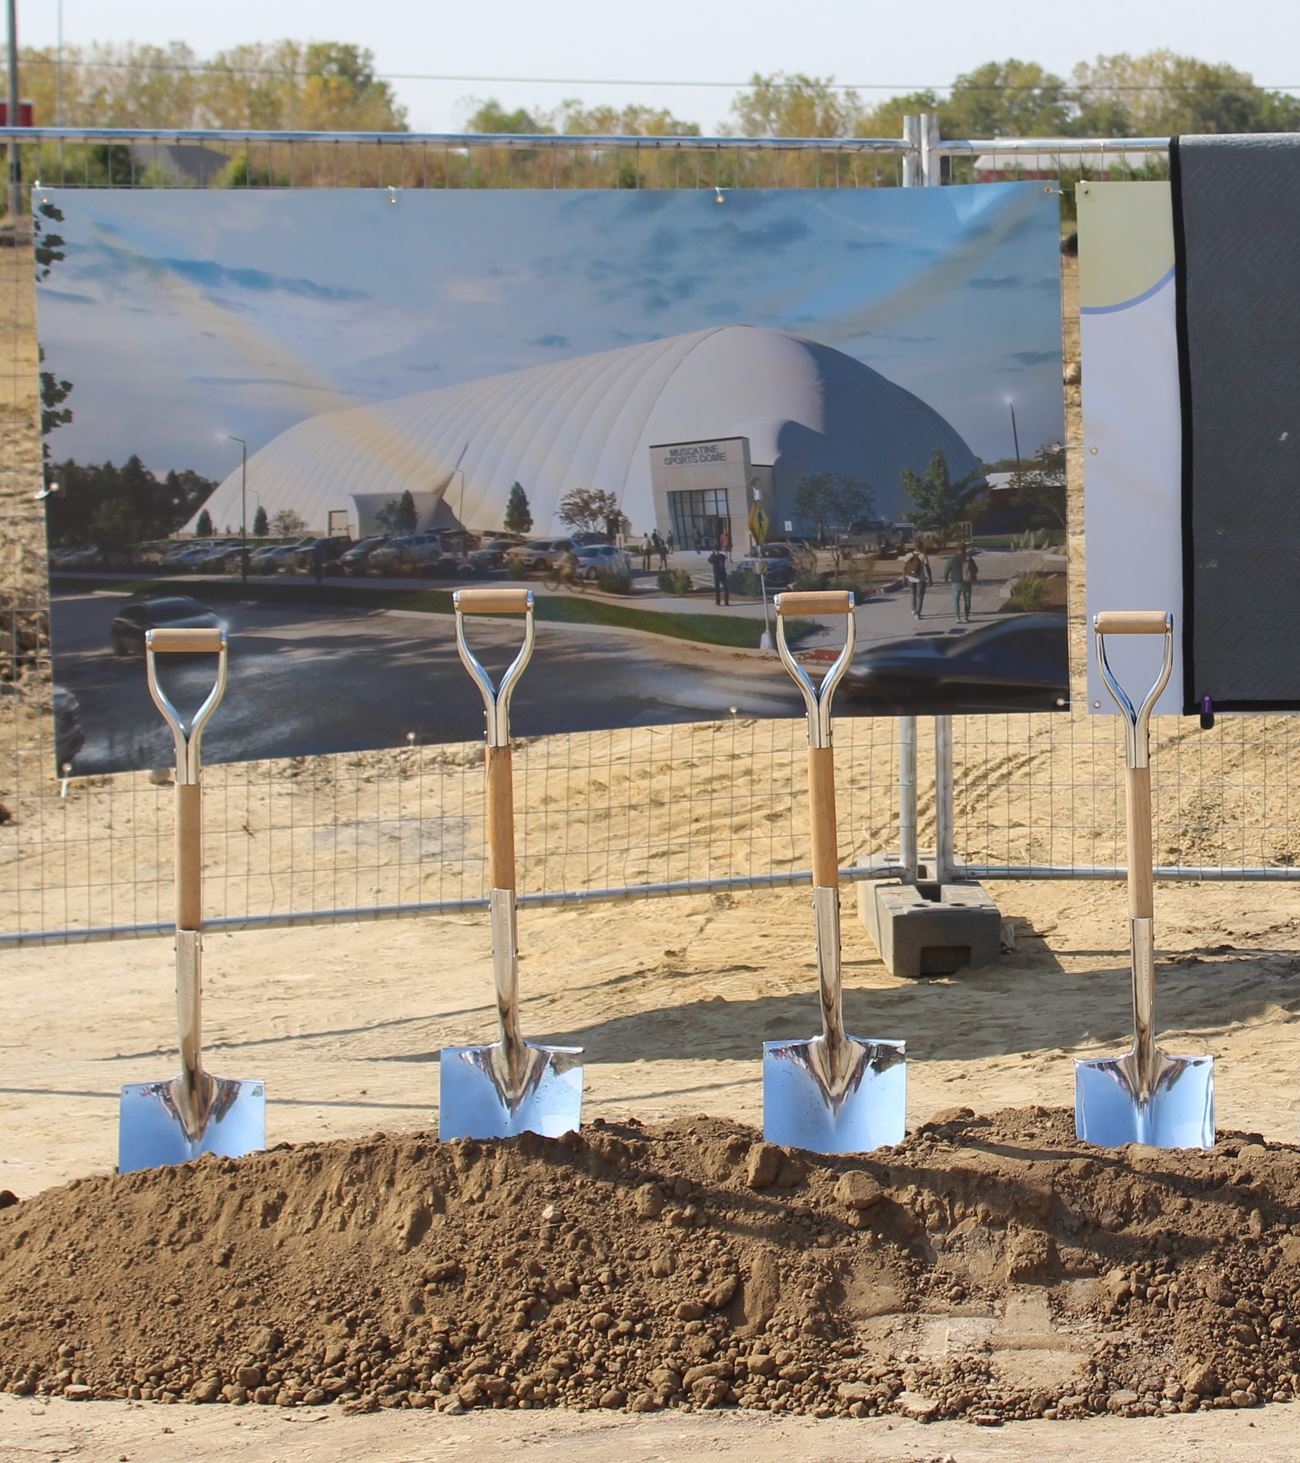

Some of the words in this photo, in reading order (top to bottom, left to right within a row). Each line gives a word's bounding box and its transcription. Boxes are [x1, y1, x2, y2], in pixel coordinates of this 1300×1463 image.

[669, 445, 719, 457] MUSCATINE
[664, 455, 698, 465] SPORTS
[700, 453, 726, 463] DOME
